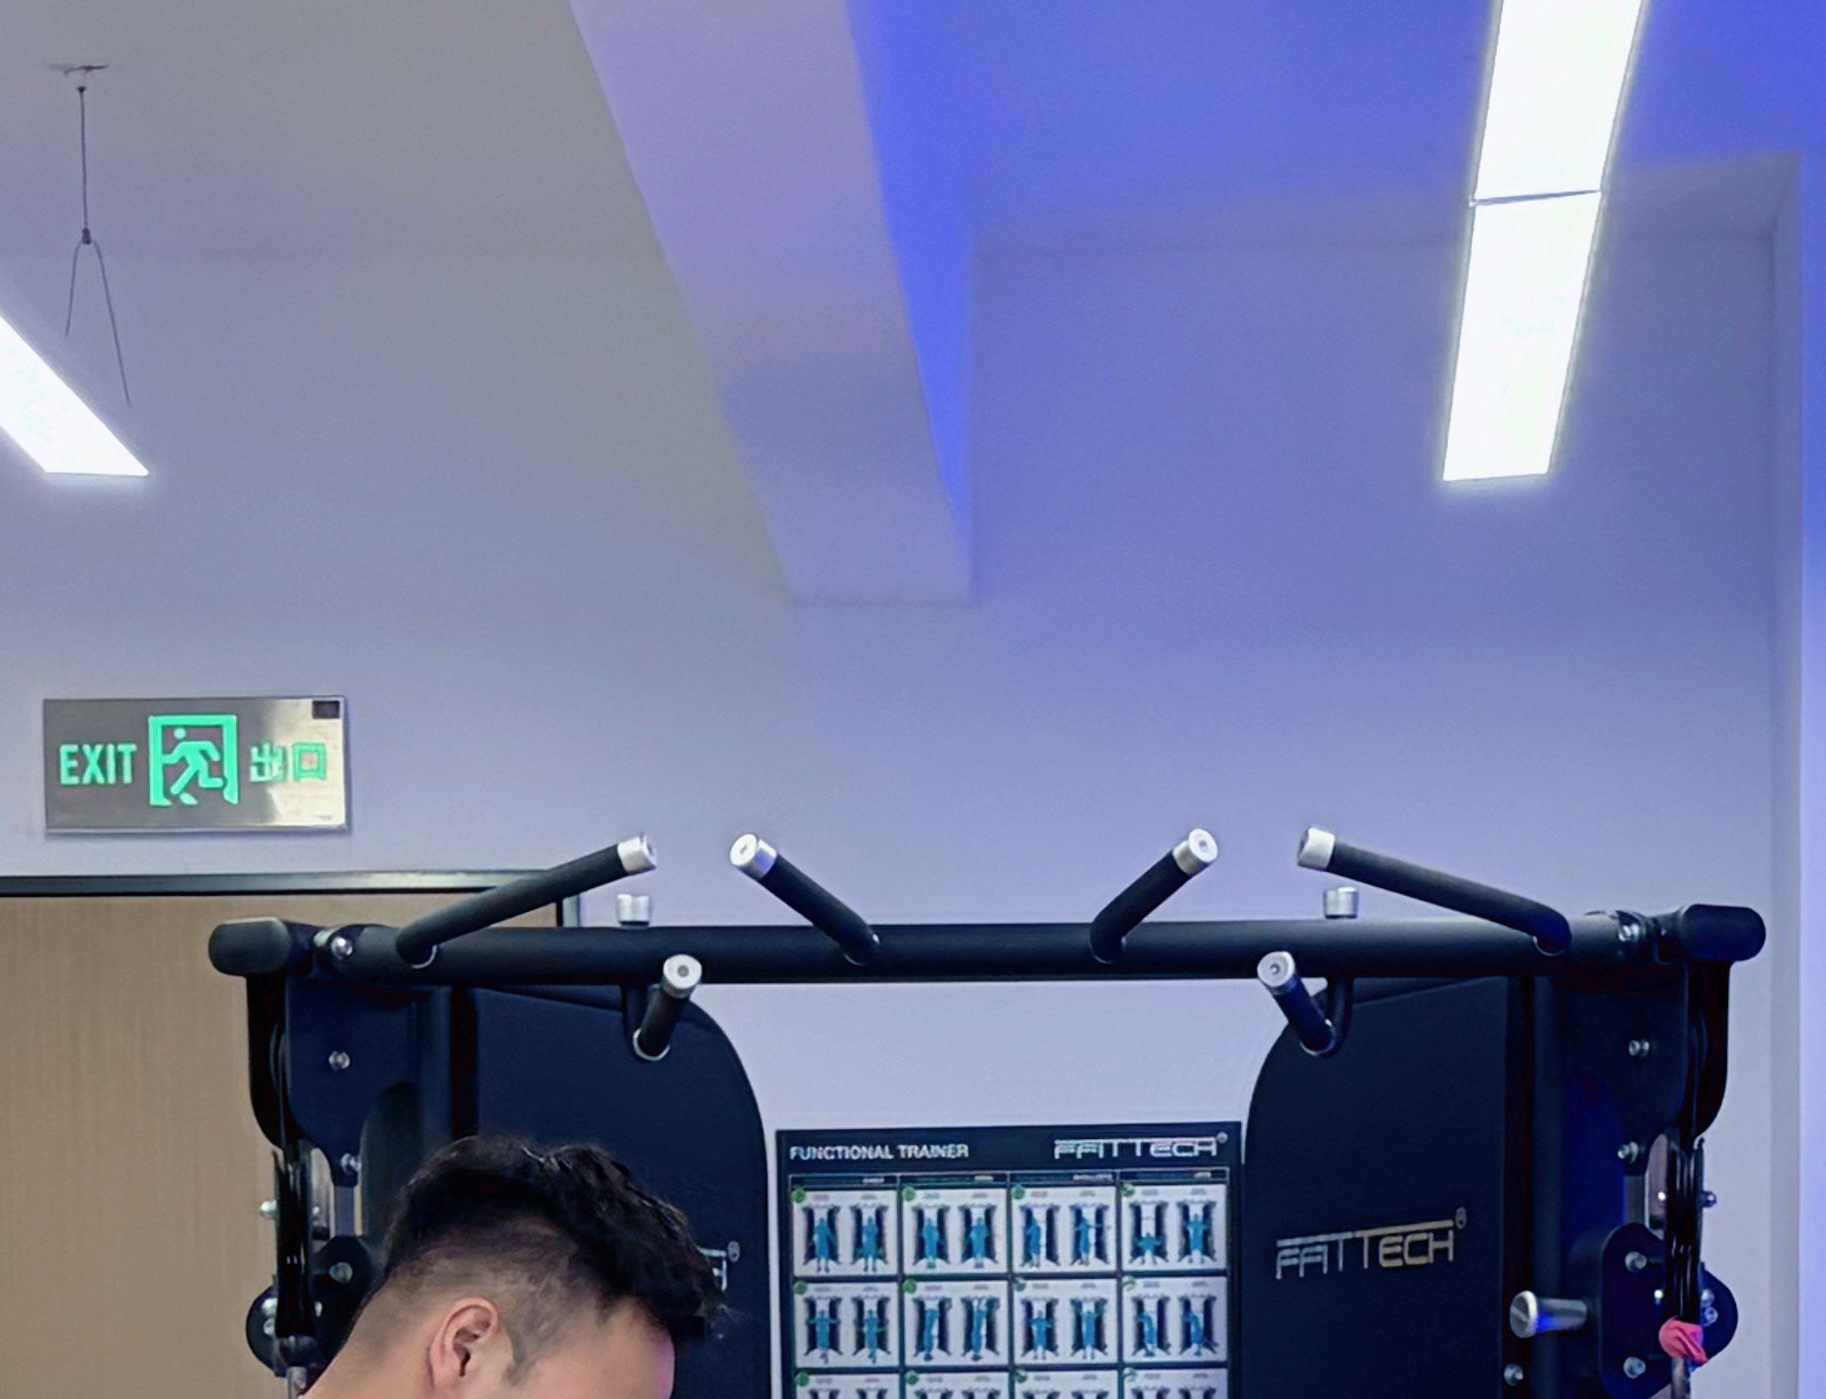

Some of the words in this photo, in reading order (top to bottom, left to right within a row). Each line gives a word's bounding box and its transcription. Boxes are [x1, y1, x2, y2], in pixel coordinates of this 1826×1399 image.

[59, 743, 138, 785] EXIT
[249, 742, 328, 784] 出口
[789, 1145, 894, 1161] FUNCTIONAL
[898, 1143, 969, 1160] TRAINER
